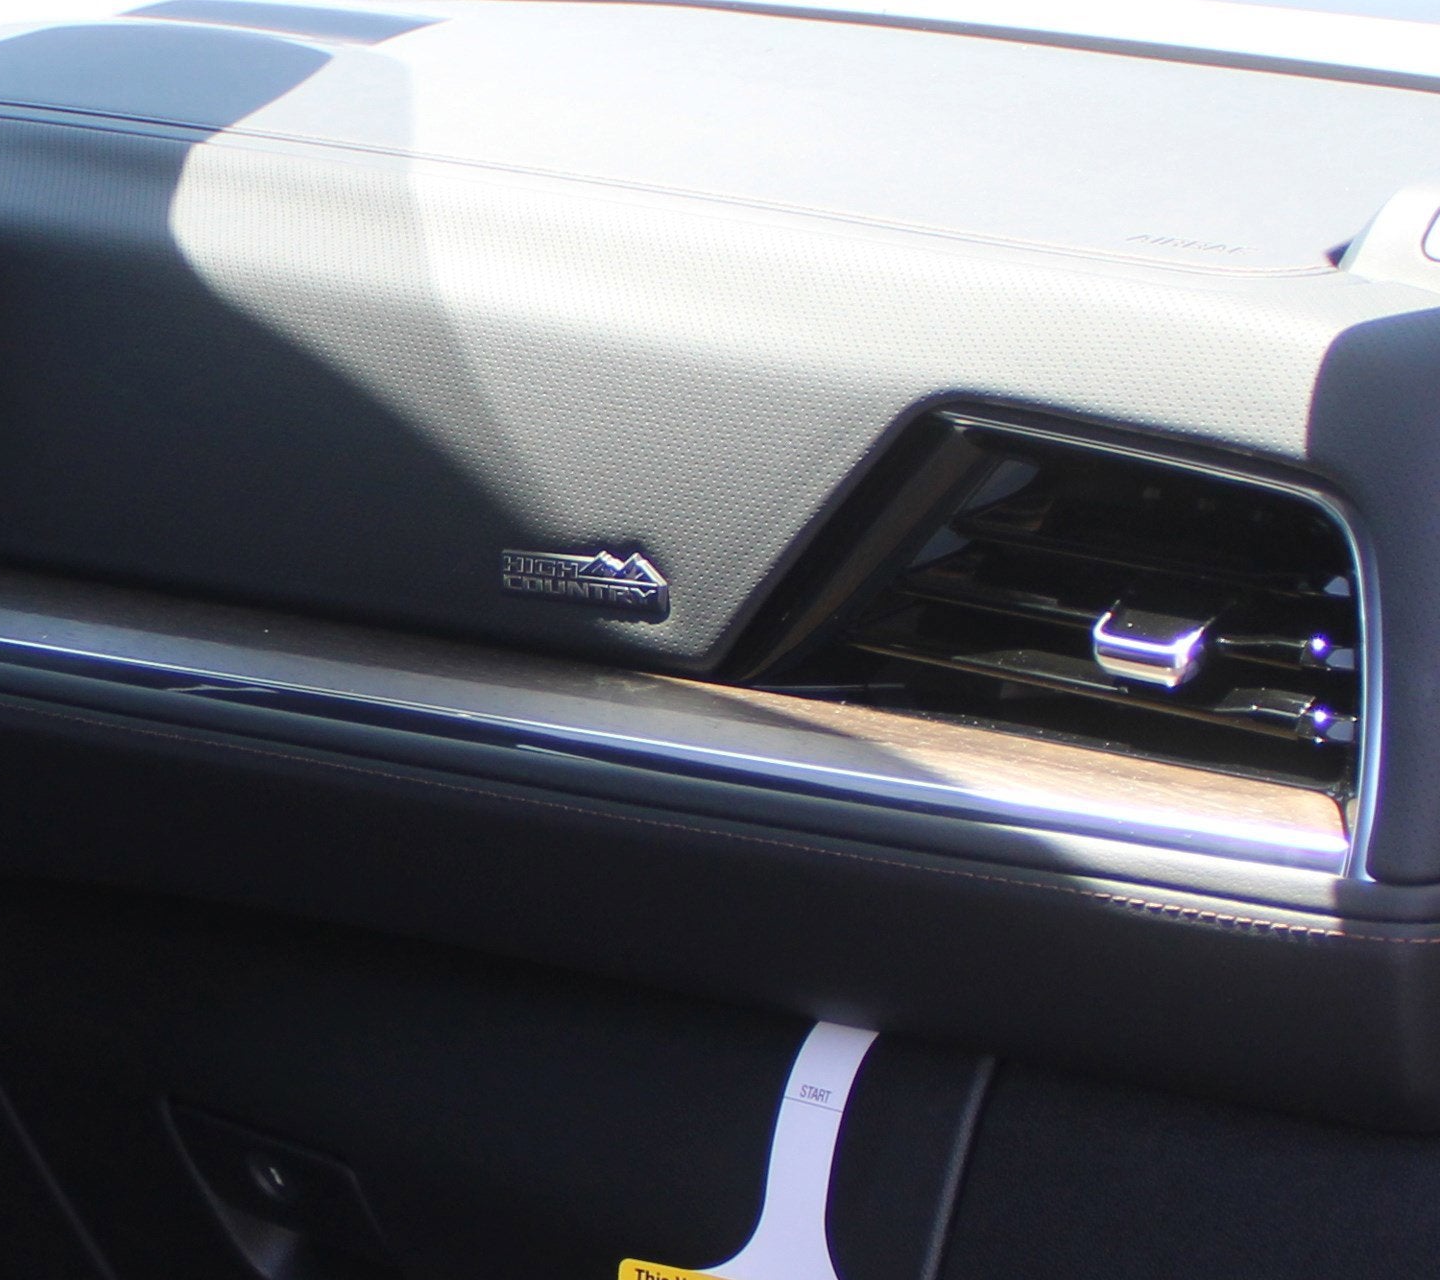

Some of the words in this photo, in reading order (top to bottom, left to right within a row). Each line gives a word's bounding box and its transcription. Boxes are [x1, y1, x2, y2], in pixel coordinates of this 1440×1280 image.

[503, 555, 579, 578] HIGH
[503, 574, 657, 606] COUNTRY
[799, 1084, 832, 1104] START
